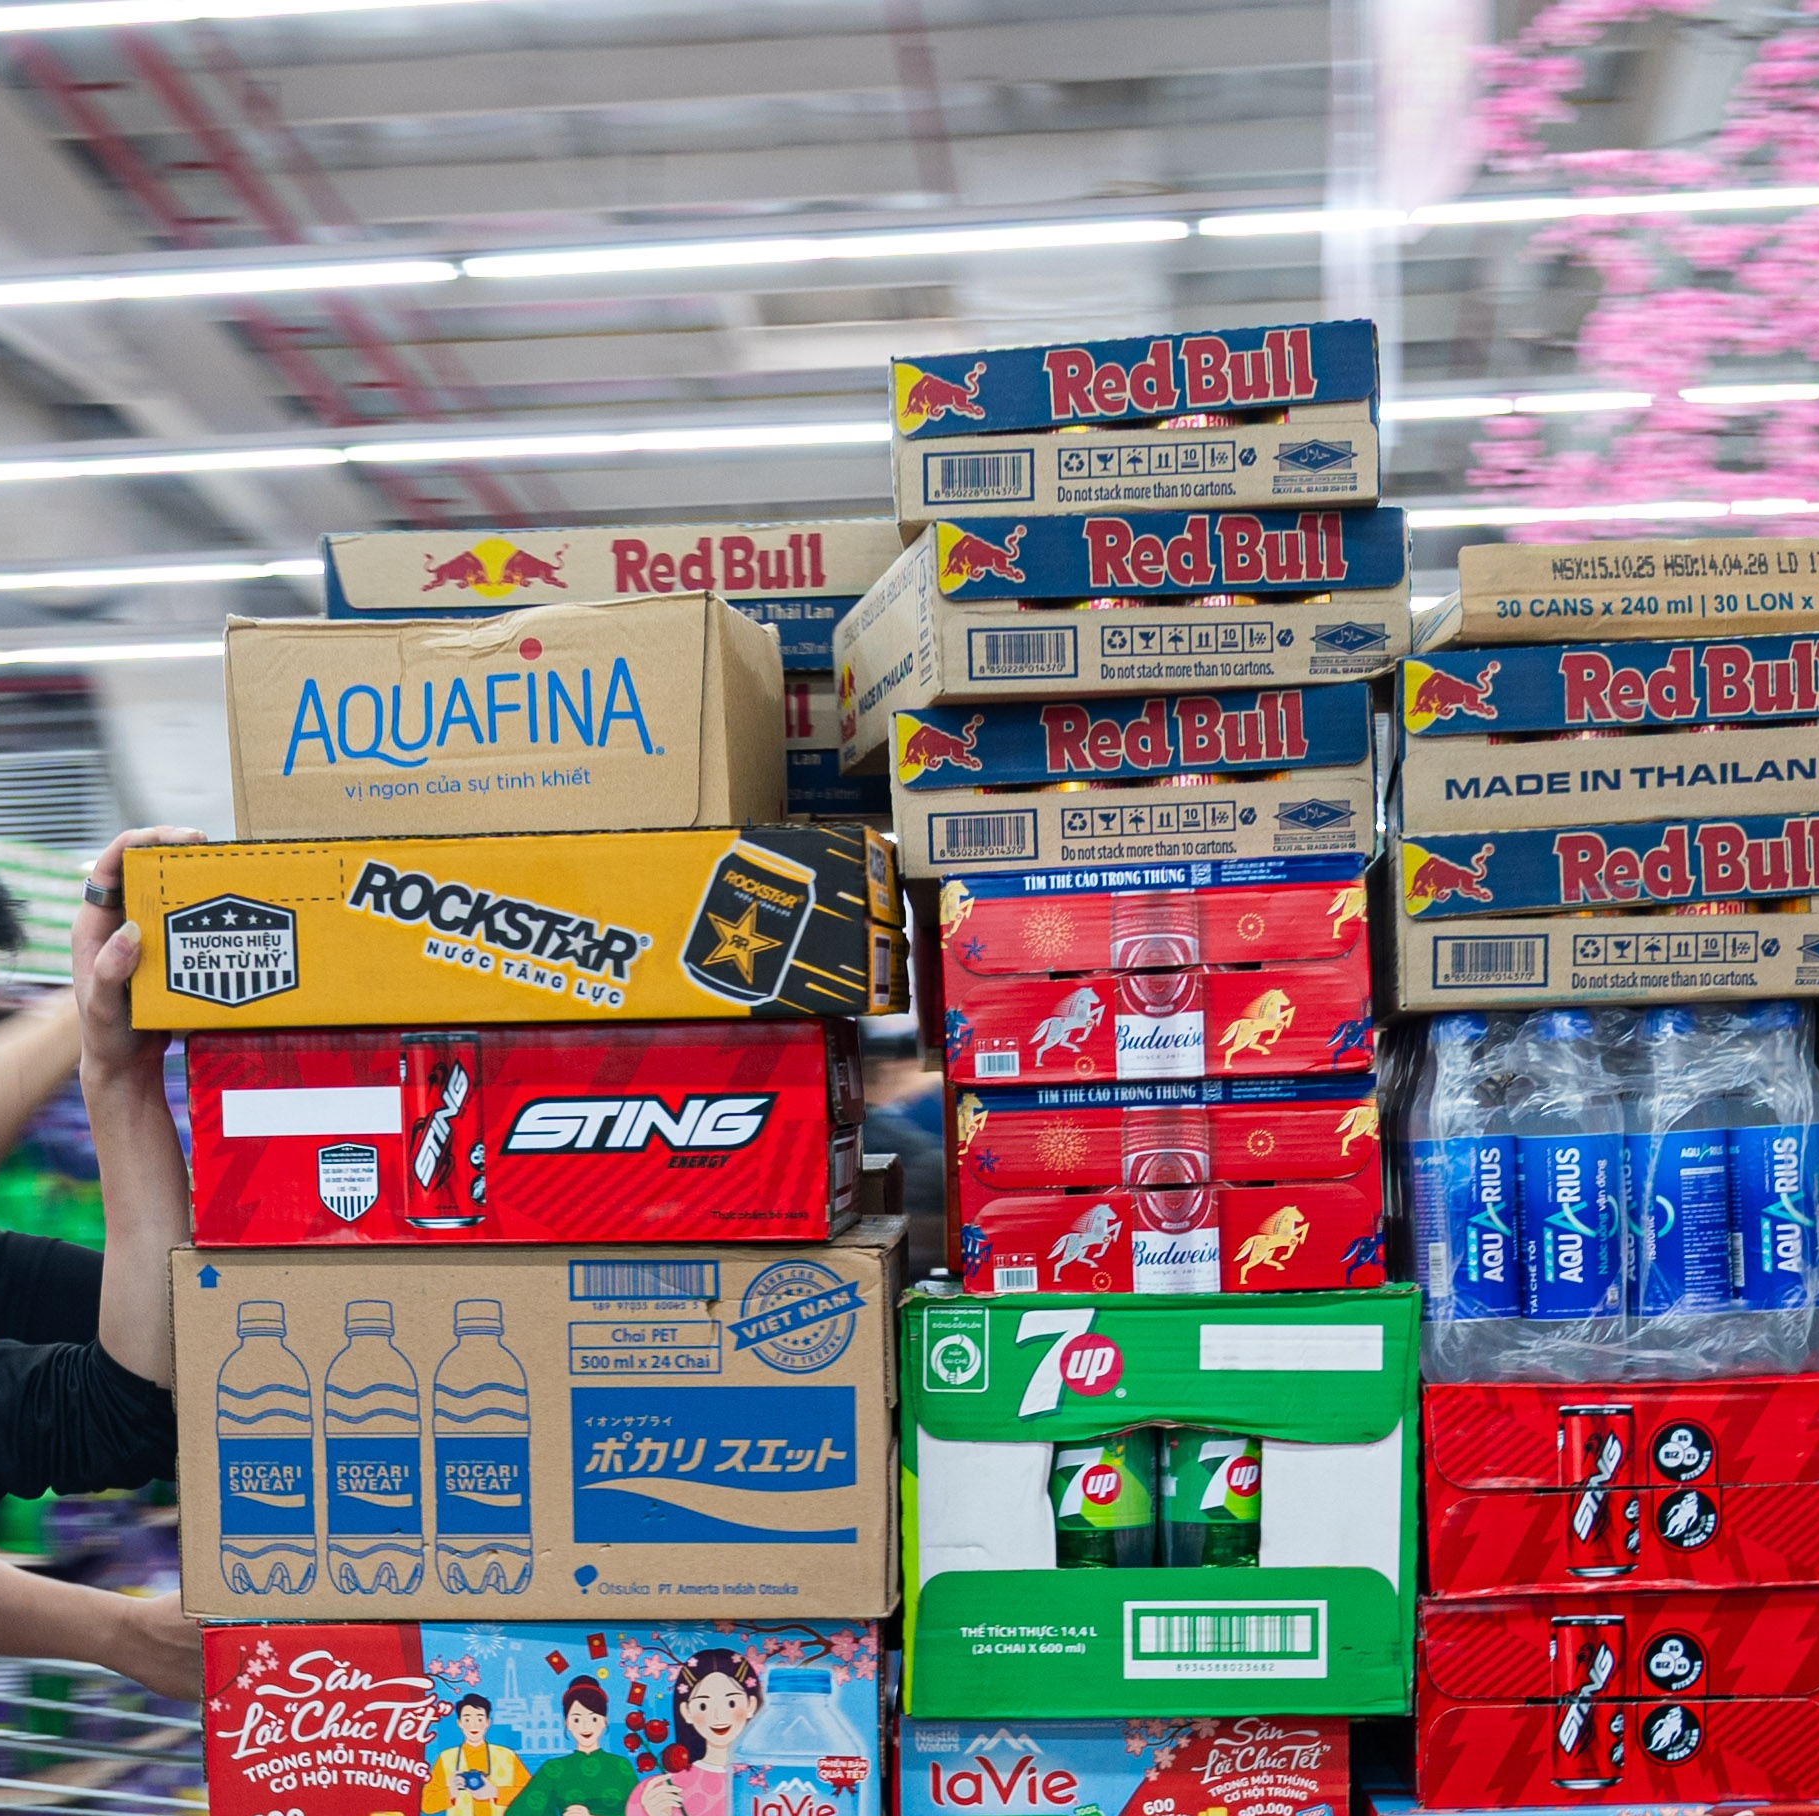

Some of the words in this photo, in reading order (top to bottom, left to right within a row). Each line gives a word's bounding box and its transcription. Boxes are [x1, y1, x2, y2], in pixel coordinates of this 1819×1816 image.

[1044, 341, 1180, 420] Red
[1180, 329, 1318, 406] Bull
[1058, 487, 1073, 502] Do
[1074, 487, 1092, 501] not
[1094, 486, 1121, 500] stack
[1122, 487, 1151, 498] more
[1152, 484, 1178, 498] than
[1180, 484, 1191, 496] 10
[1193, 482, 1236, 496] cartons.
[611, 539, 715, 592] Red
[718, 532, 826, 591] Bull
[1083, 518, 1217, 587] Red
[1216, 512, 1348, 584] Bull
[766, 604, 801, 620] Thái
[805, 605, 834, 619] Lan
[1497, 600, 1522, 618] 30
[1529, 598, 1593, 617] CANS
[1601, 602, 1613, 615] x
[1621, 596, 1659, 615] 240
[1665, 594, 1693, 614] ml
[1714, 595, 1738, 614] 30
[1745, 592, 1792, 612] LON
[1802, 597, 1815, 610] x
[1559, 647, 1701, 724] Red
[282, 657, 665, 776] AQUAFINA
[1041, 699, 1177, 773] Red
[1176, 690, 1310, 763] Bull
[345, 783, 363, 801] vị
[368, 779, 419, 799] ngon
[425, 776, 461, 795] của
[466, 775, 492, 794] sự
[496, 771, 536, 791] tinh
[542, 767, 592, 789] khiết
[1444, 772, 1572, 800] MADE
[1579, 770, 1621, 792] IN
[1024, 874, 1047, 892] TÌM
[1050, 870, 1073, 891] THẺ
[1075, 871, 1098, 889] CÀO
[1101, 870, 1142, 888] TRONG
[1144, 868, 1185, 886] THÙNG
[348, 860, 644, 980] ROCKSTAR
[180, 934, 242, 950] THƯƠNG
[248, 932, 281, 951] HIỆU
[183, 950, 221, 970] ĐẾN
[225, 951, 251, 969] TỪ
[425, 940, 490, 972] NƯỚC
[502, 960, 564, 991] TĂNG
[575, 979, 624, 1006] LỰC
[507, 1098, 767, 1150] STING
[668, 1155, 731, 1170] ENERGY
[740, 1307, 793, 1341] VIỆT
[800, 1289, 851, 1320] NAM
[611, 1328, 646, 1343] Chai
[651, 1329, 678, 1342] PET
[580, 1355, 610, 1369] 500
[614, 1355, 634, 1369] ml
[638, 1358, 647, 1368] x
[652, 1356, 670, 1368] 24
[675, 1355, 710, 1369] Chai
[584, 1415, 673, 1428] イオンサプライ
[228, 1466, 304, 1480] POCARI
[228, 1478, 296, 1492] SWEAT
[597, 1580, 651, 1596] Otsuka
[961, 1622, 986, 1638] THỂ
[988, 1623, 1018, 1638] TÍCH
[1020, 1625, 1058, 1641] THỰC:
[1060, 1626, 1087, 1640] 14,4
[1089, 1627, 1097, 1638] L
[971, 1642, 991, 1656] (24
[994, 1642, 1026, 1654] CHAI
[1028, 1642, 1038, 1654] X
[1039, 1642, 1062, 1655] 600
[1065, 1642, 1086, 1656] ml)
[254, 1650, 434, 1698] Săn
[216, 1702, 288, 1761] Lời
[243, 1752, 314, 1783] TRONG
[316, 1746, 357, 1765] MỖI
[359, 1749, 432, 1782] THÙNG,
[269, 1772, 298, 1793] CƠ
[303, 1770, 340, 1790] HỘI
[342, 1770, 412, 1794] TRÚNG
[931, 1755, 1079, 1808] laVie
